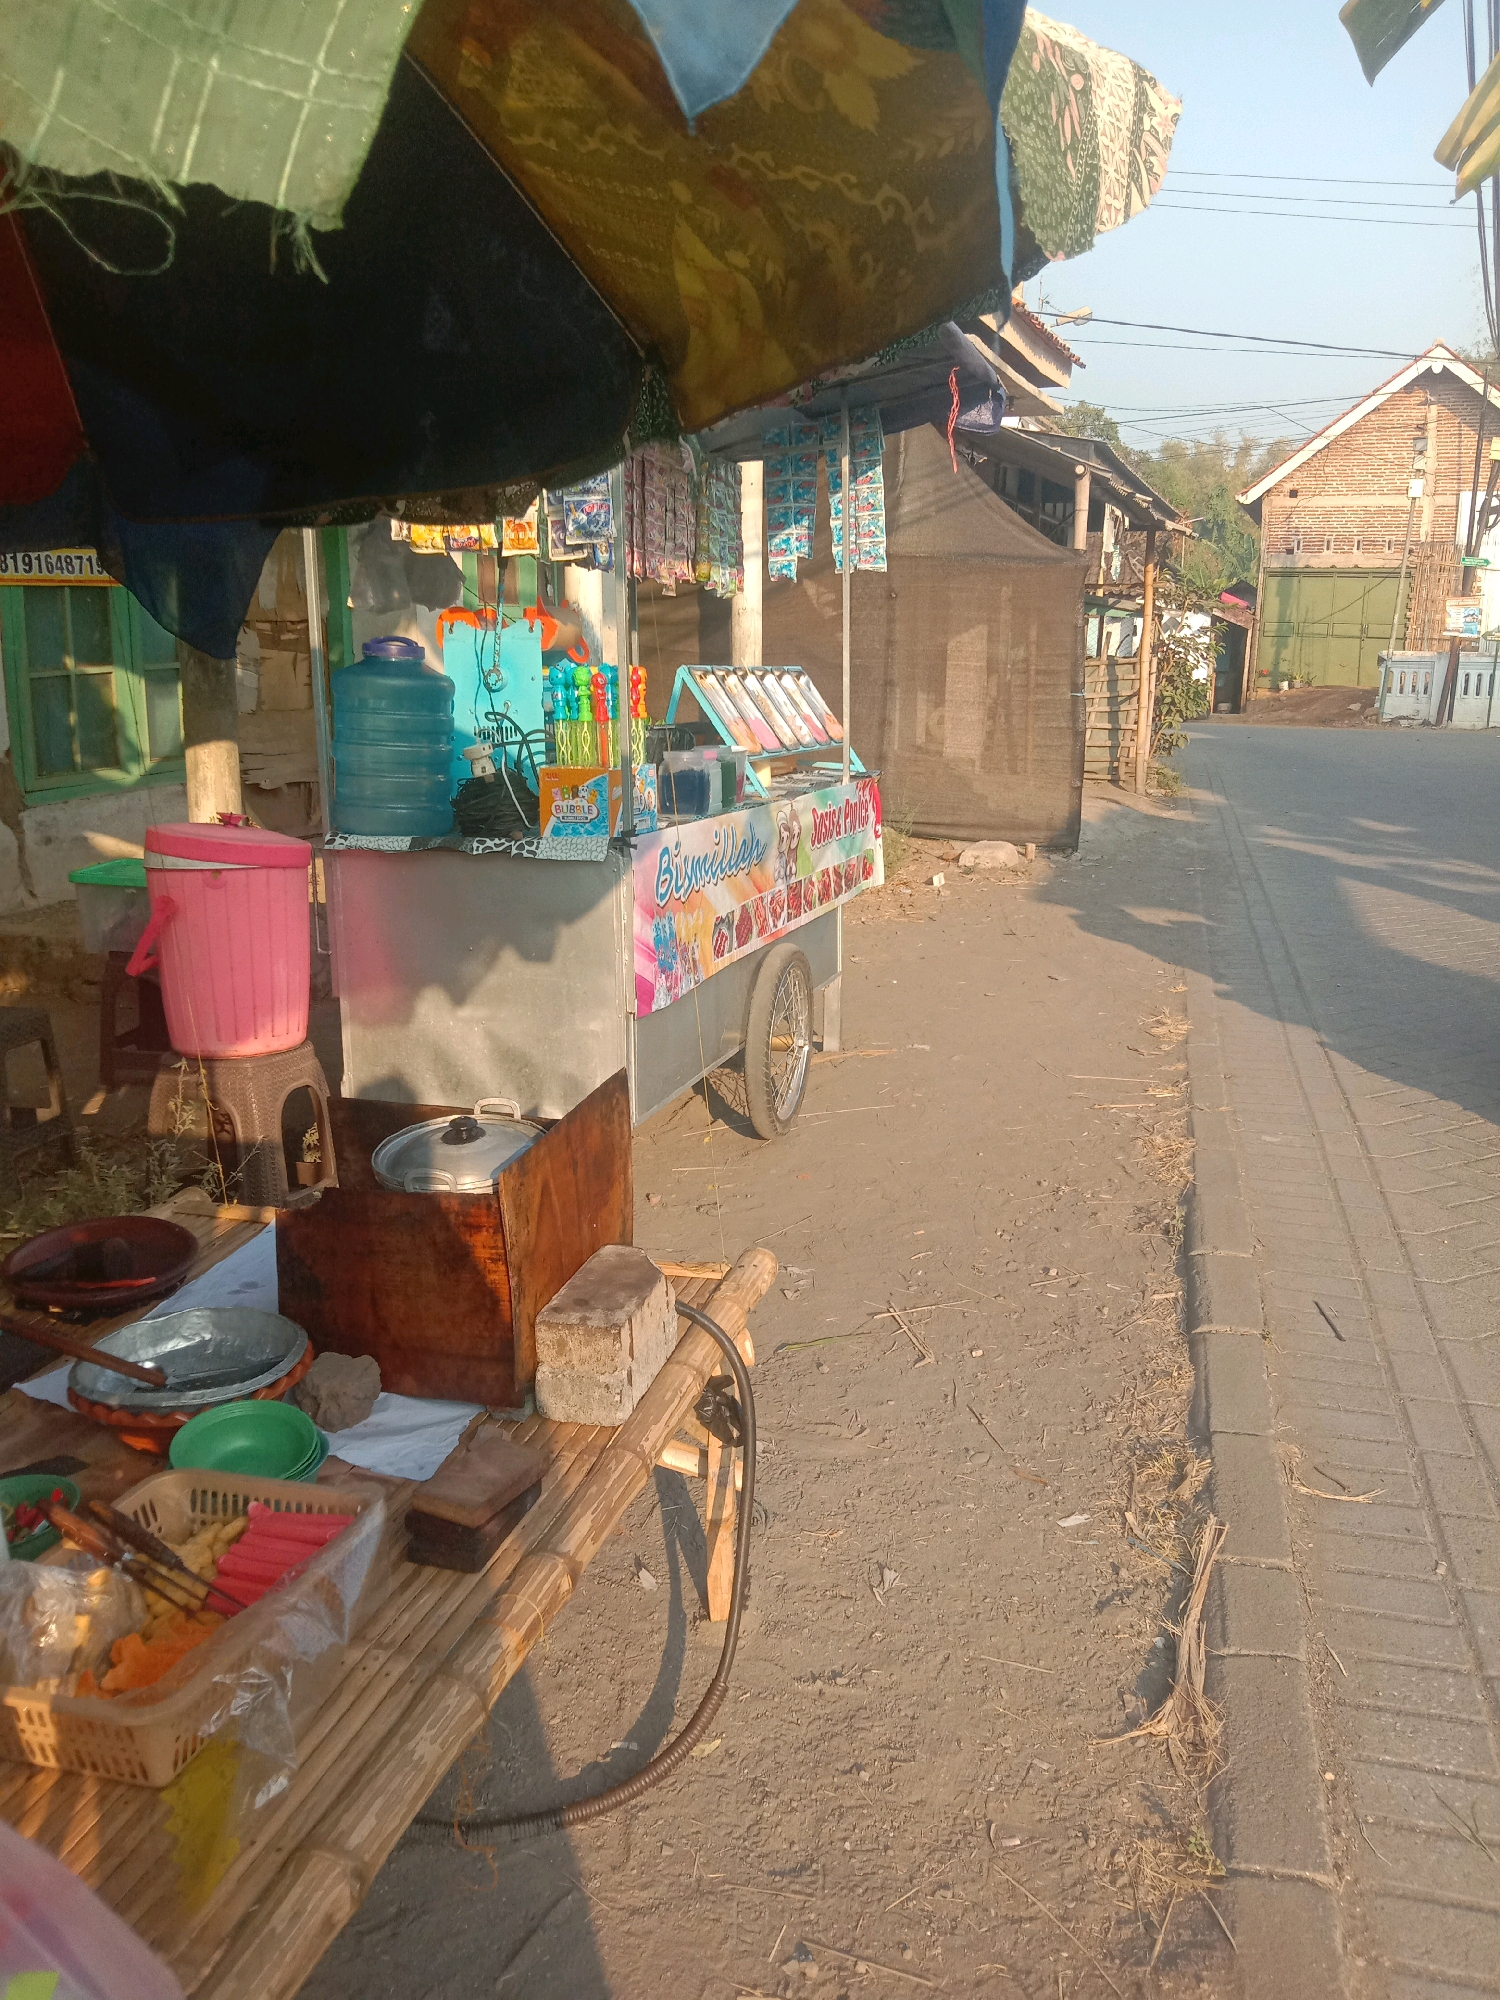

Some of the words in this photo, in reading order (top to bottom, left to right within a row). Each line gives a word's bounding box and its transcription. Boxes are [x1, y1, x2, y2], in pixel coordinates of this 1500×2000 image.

[554, 804, 594, 815] BUBBLE
[811, 802, 837, 849] Sosis
[655, 822, 766, 907] Bismillah
